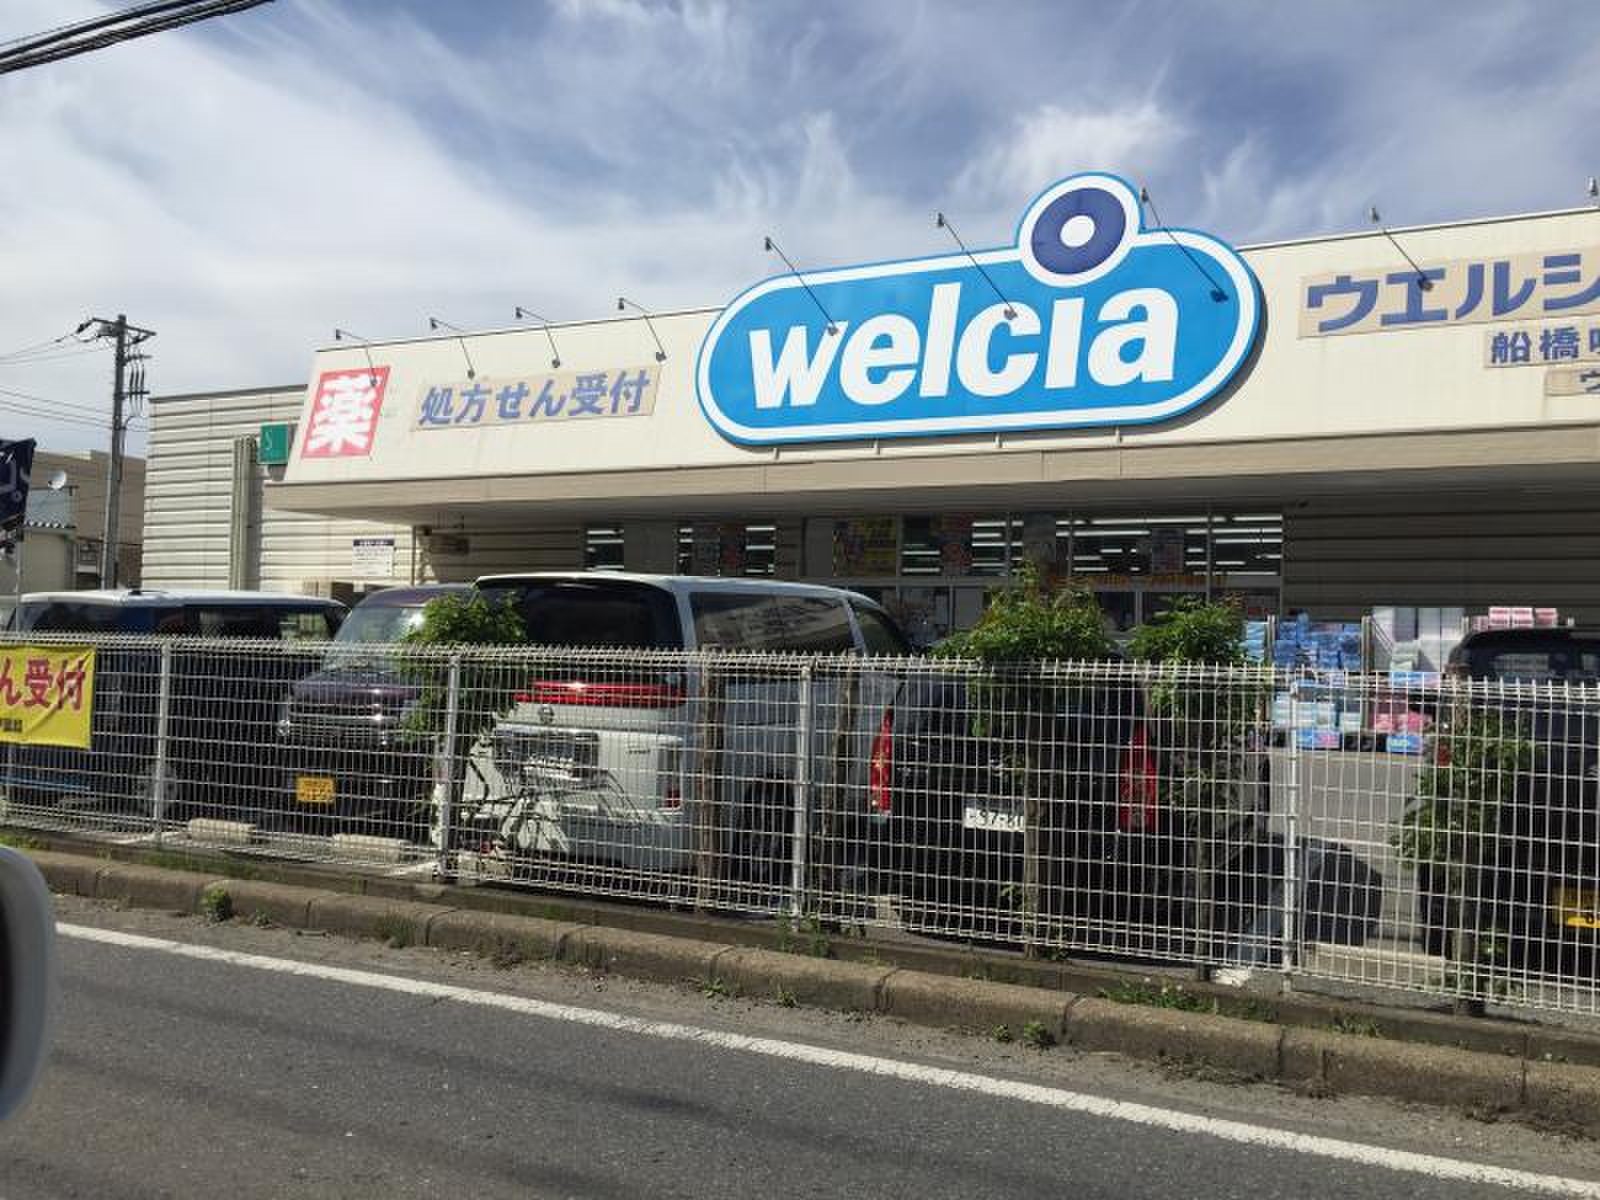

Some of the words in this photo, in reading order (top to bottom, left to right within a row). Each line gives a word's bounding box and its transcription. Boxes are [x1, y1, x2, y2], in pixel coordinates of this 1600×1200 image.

[1307, 253, 1600, 332] ウエルシ
[748, 282, 1180, 409] welcia
[1491, 326, 1600, 364] 船橋
[306, 373, 384, 454] 薬
[418, 369, 650, 426] 処方せん受付
